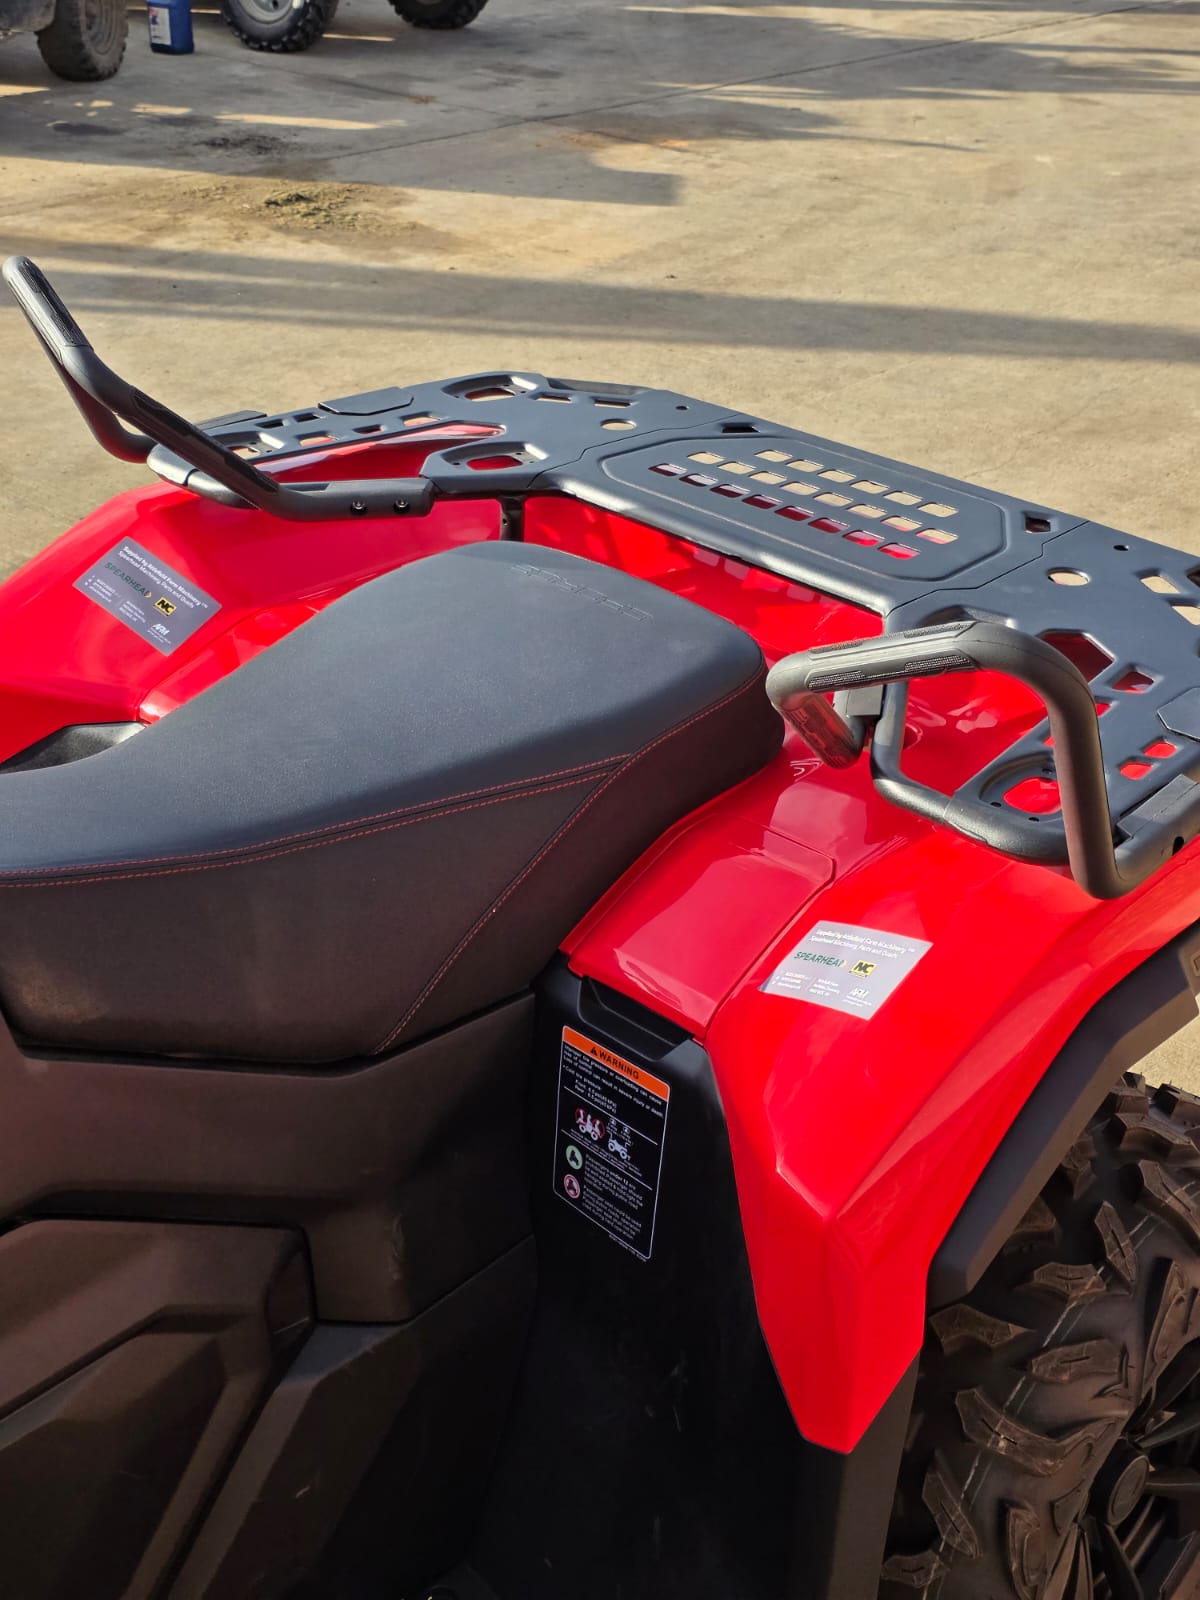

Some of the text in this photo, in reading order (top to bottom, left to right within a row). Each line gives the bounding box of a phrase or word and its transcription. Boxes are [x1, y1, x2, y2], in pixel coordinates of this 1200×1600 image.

[140, 566, 162, 584] Machinery
[161, 582, 174, 592] Parts
[166, 577, 179, 588] Farm
[178, 586, 202, 605] Machinery
[157, 599, 174, 613] NC
[853, 962, 874, 974] NC
[599, 1049, 639, 1080] WARNING
